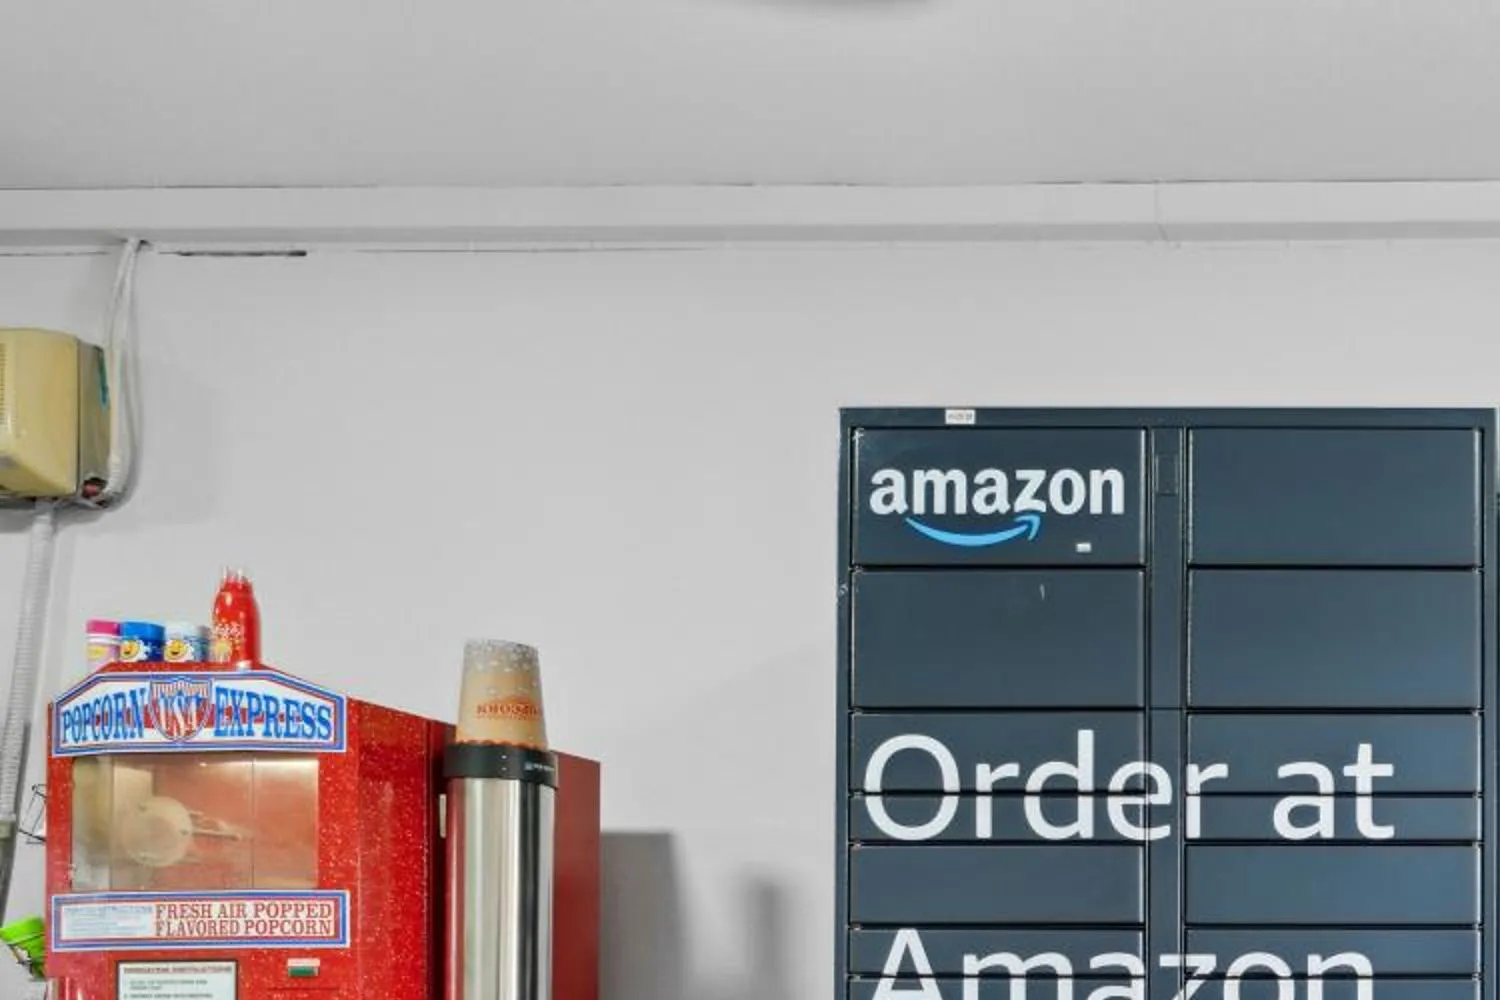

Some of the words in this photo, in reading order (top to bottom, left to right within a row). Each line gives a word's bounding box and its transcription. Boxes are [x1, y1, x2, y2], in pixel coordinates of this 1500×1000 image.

[869, 468, 1124, 515] amazon
[62, 685, 148, 744] POPCORN
[213, 686, 332, 740] EXPRESS
[863, 729, 1228, 841] Order
[1272, 743, 1395, 840] at
[156, 903, 212, 919] FRESH
[219, 903, 247, 919] AIR
[254, 903, 332, 919] POPPED
[156, 920, 239, 936] FLAVORED
[244, 920, 332, 935] POPCORN
